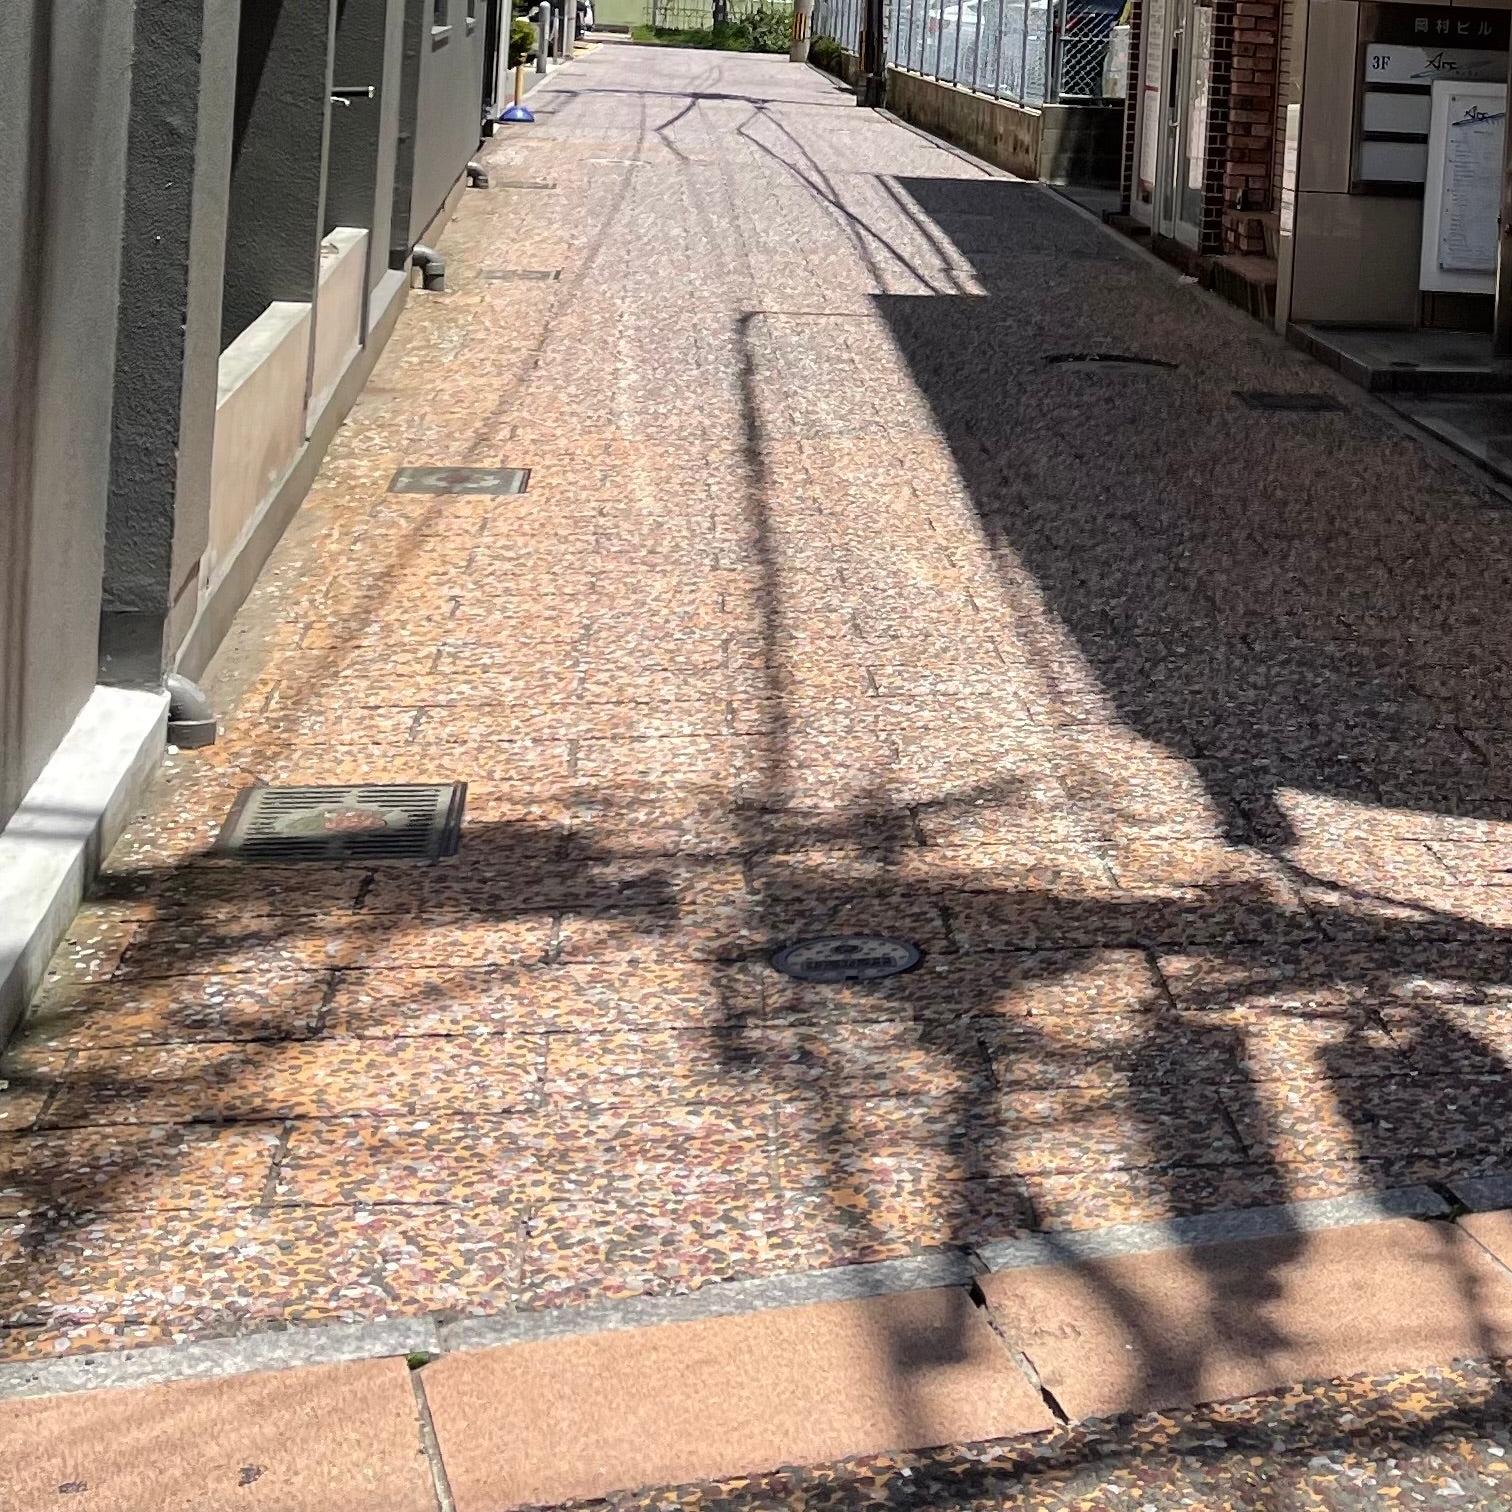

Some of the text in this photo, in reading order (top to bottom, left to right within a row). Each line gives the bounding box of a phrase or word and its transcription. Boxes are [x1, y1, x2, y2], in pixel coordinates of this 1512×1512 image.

[1414, 17, 1493, 37] 岡村ビル
[1372, 55, 1391, 70] 3F
